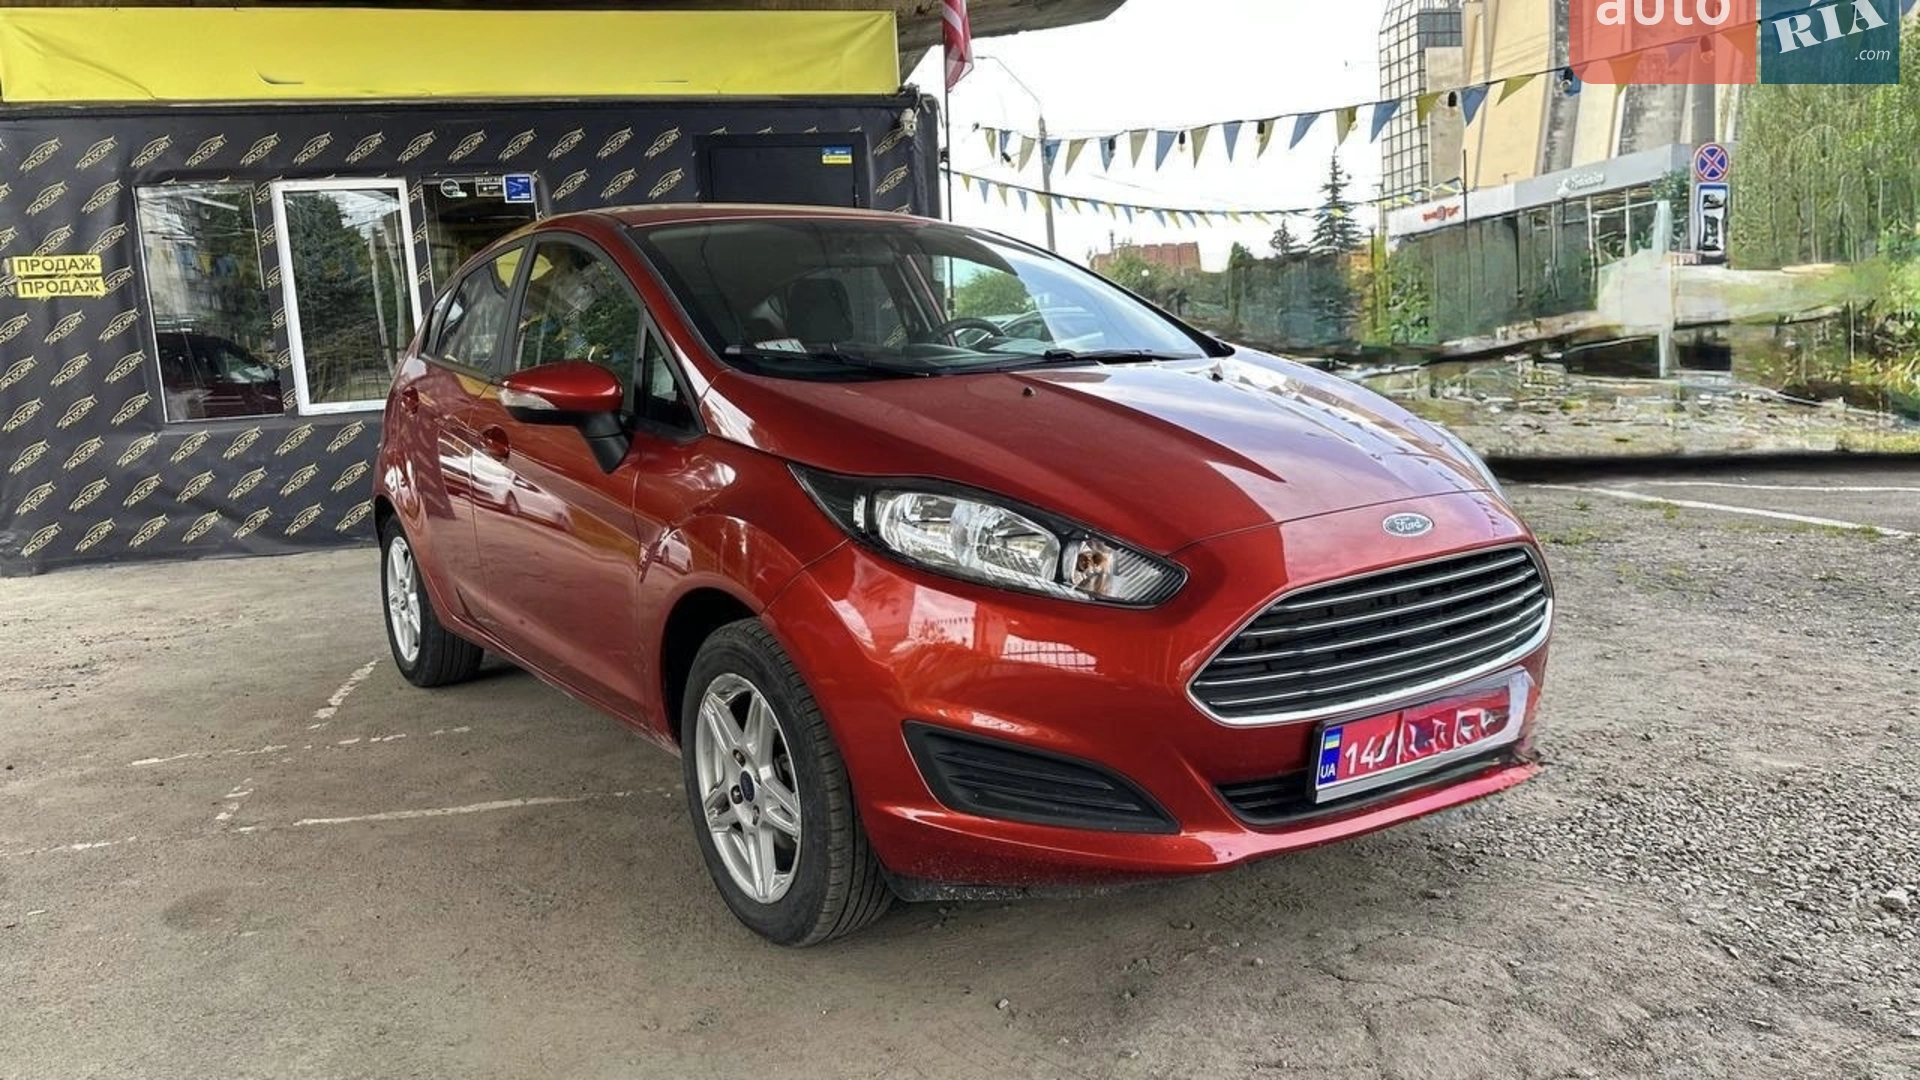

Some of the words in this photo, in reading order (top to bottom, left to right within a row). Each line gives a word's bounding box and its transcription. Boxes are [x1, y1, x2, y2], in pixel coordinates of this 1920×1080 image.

[18, 257, 95, 273] ПРОДАЖ
[22, 279, 100, 295] ПРОДАЖ
[1394, 516, 1424, 531] Ford
[1320, 764, 1336, 779] UA
